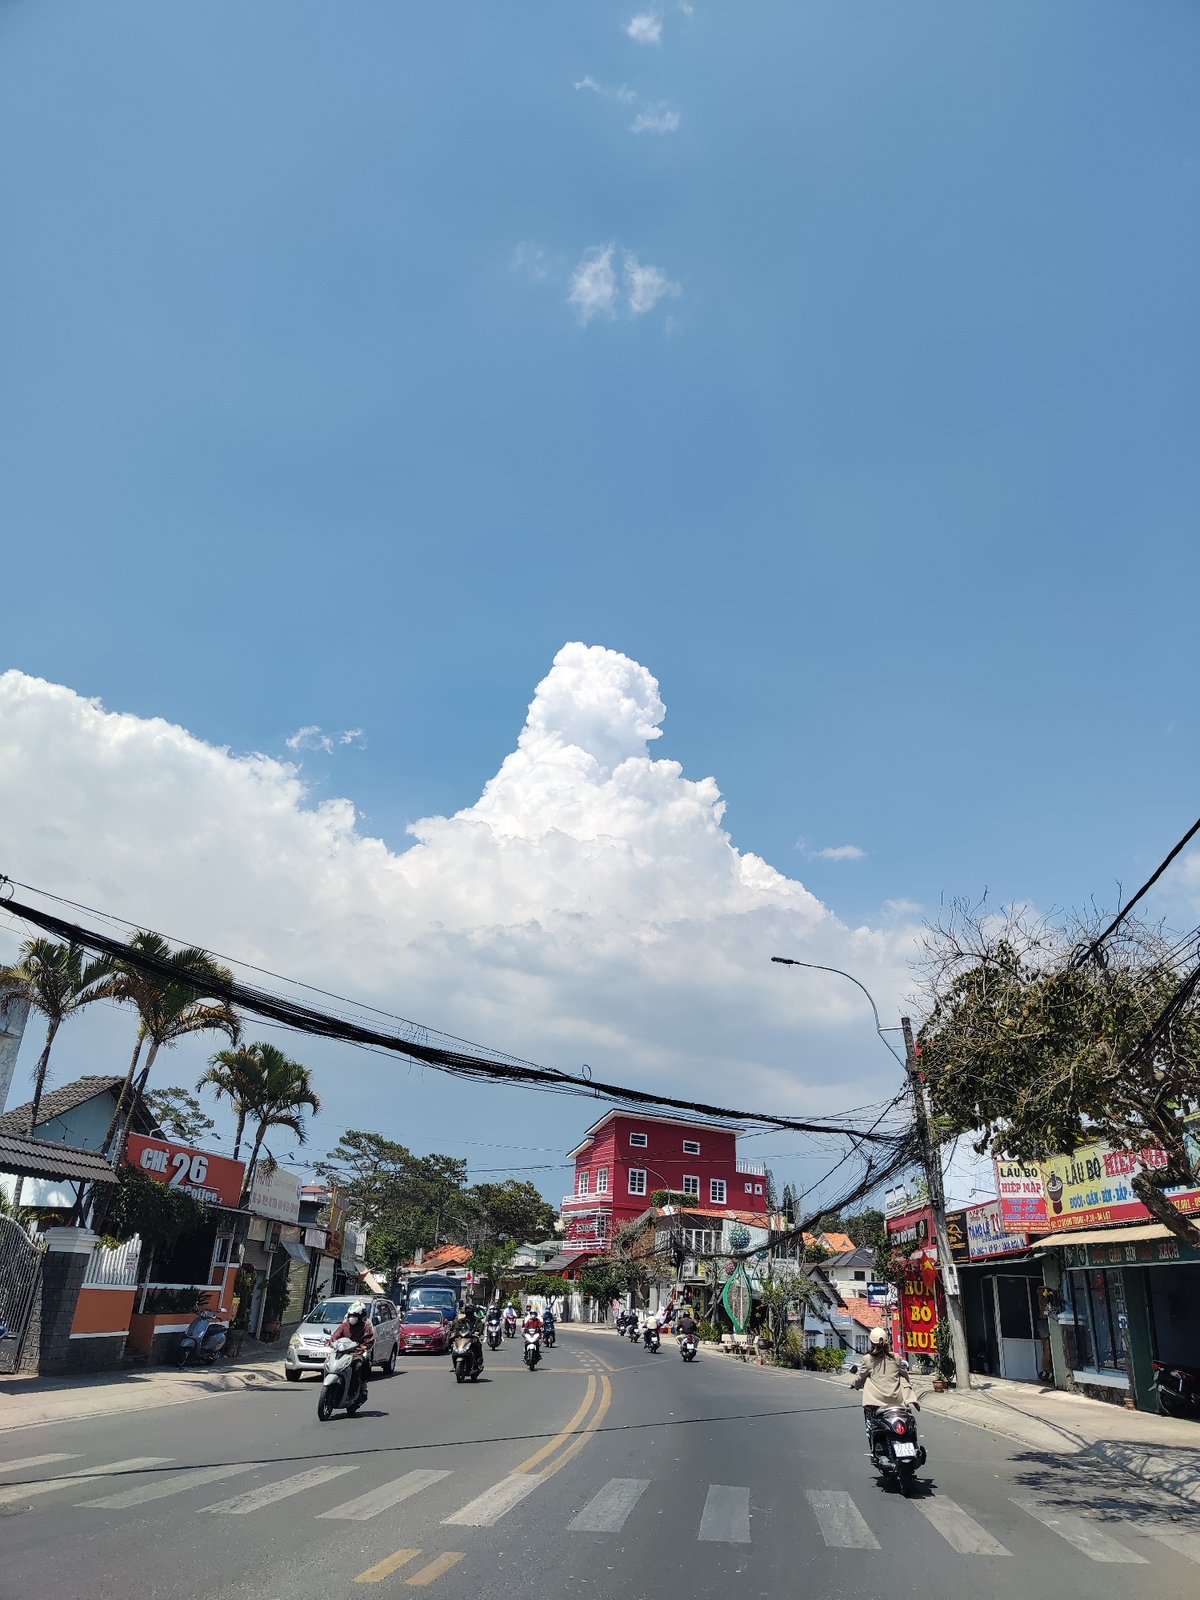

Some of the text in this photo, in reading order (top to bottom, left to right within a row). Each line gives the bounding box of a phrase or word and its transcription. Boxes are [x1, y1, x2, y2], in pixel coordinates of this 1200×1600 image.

[140, 1147, 209, 1189] CHÈ 26
[1000, 1163, 1020, 1178] LẨU
[1086, 1151, 1102, 1182] BÒ
[911, 1301, 932, 1322] BÒ
[906, 1324, 938, 1349] HUẾ
